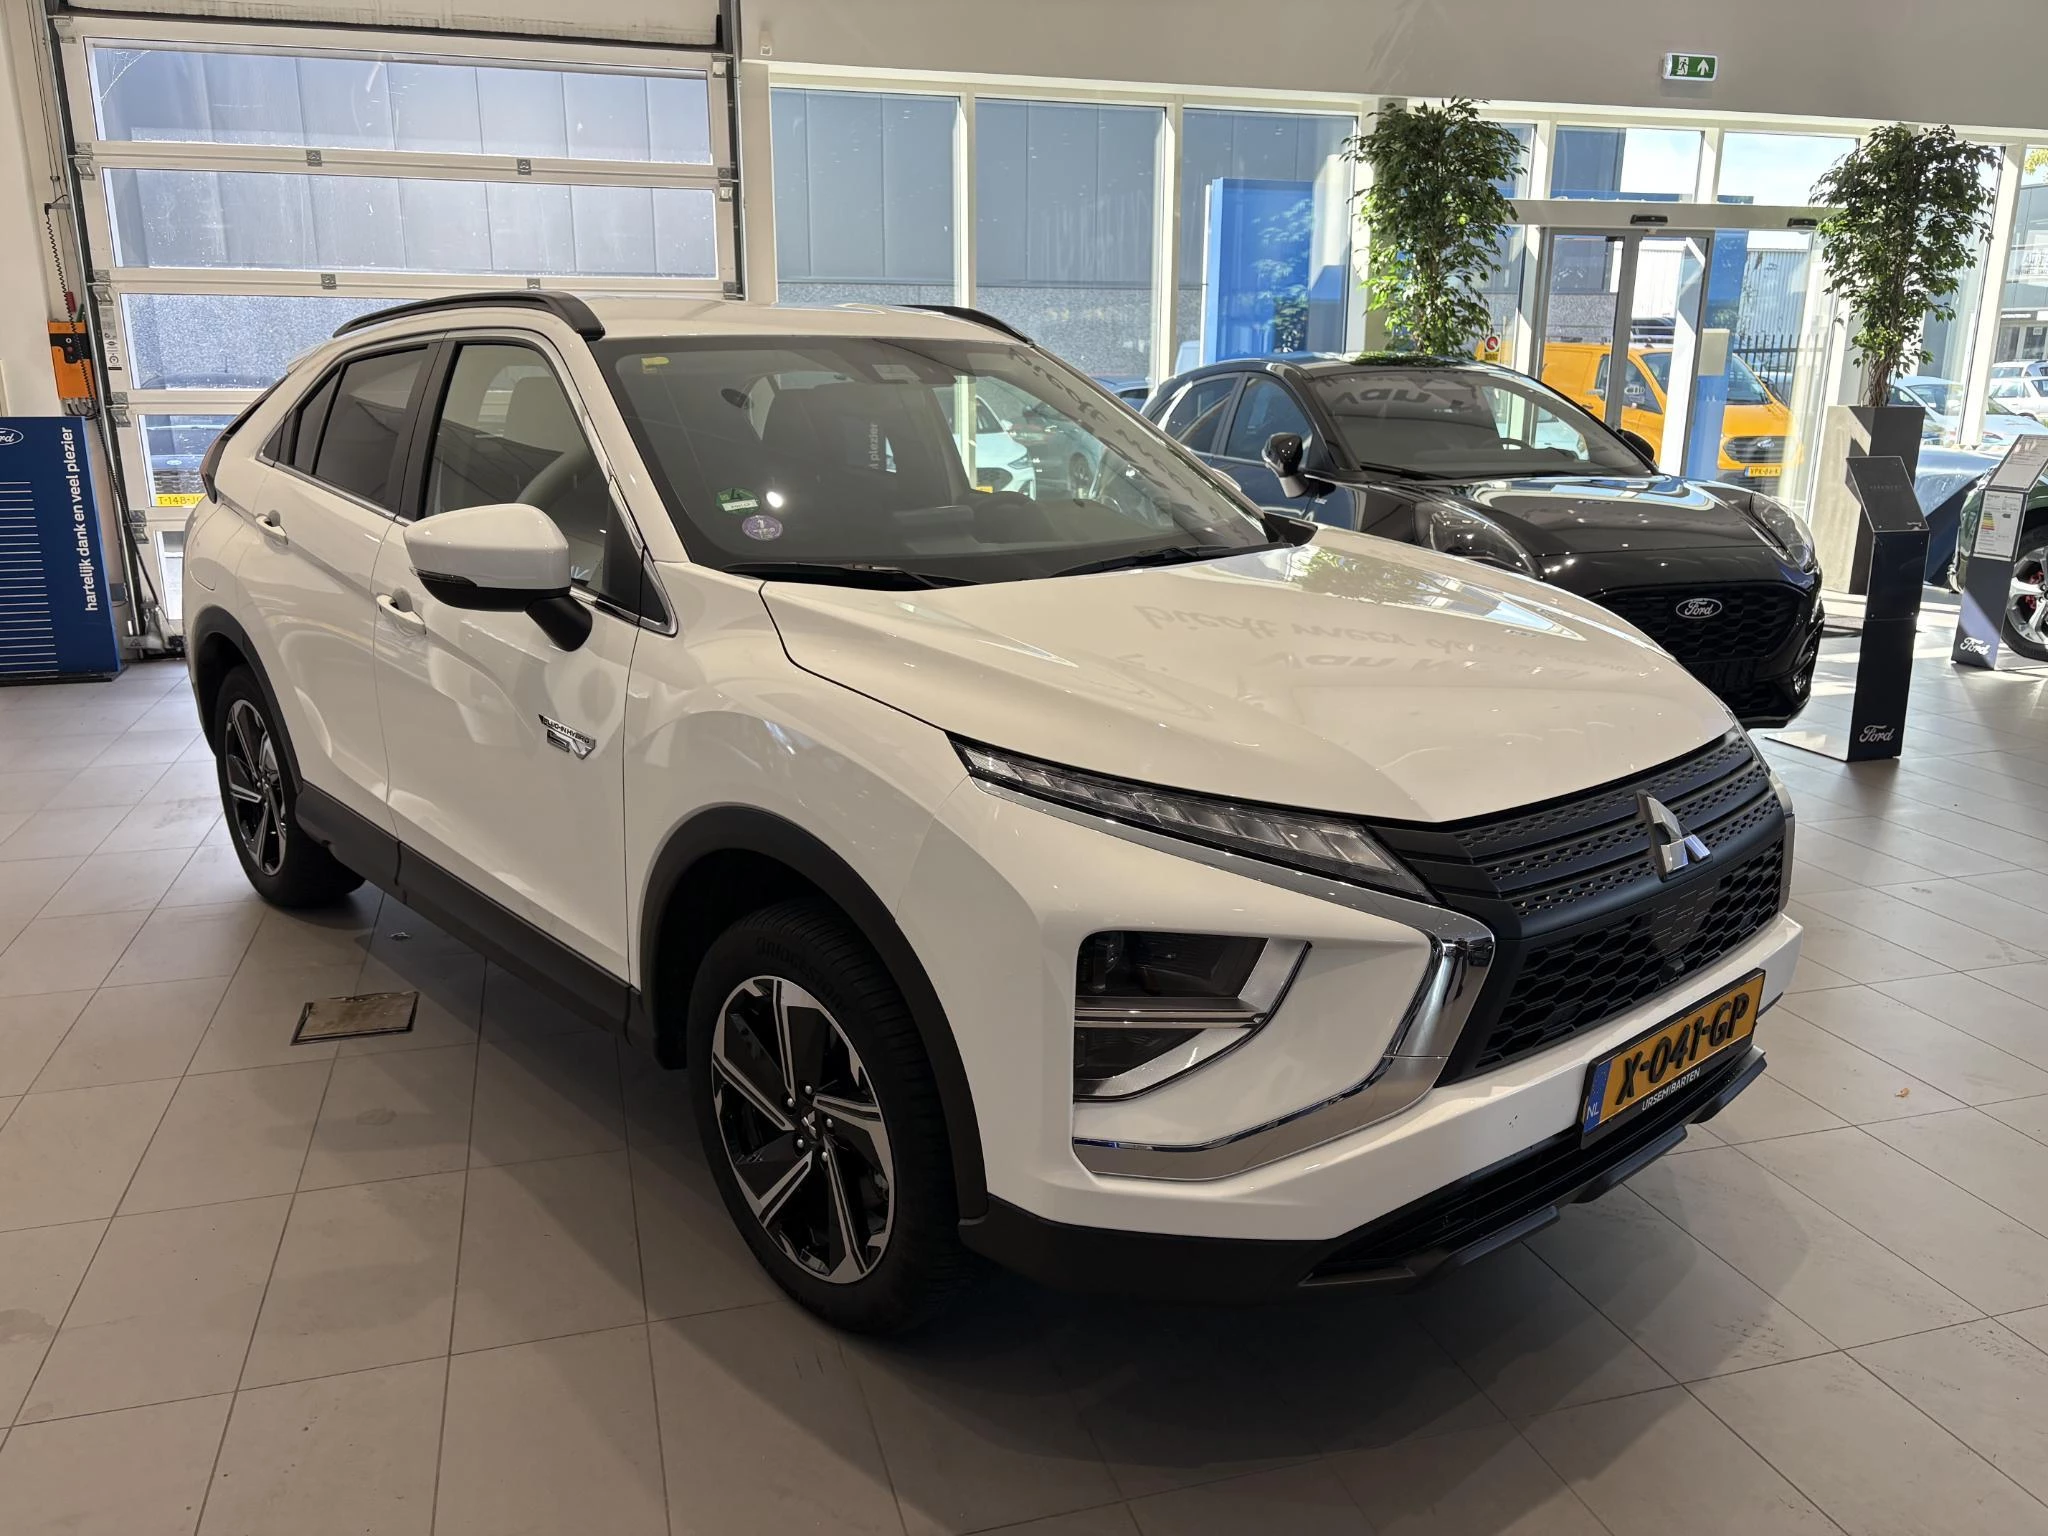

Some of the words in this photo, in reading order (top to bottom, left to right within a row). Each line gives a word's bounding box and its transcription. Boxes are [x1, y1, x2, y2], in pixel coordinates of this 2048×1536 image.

[62, 427, 80, 473] plezier
[66, 475, 81, 504] veel
[73, 505, 85, 522] en
[74, 524, 90, 557] dank
[76, 558, 98, 612] hartelijk
[1684, 600, 1714, 616] Ford
[1960, 636, 1991, 656] Ford
[1859, 724, 1896, 743] Ford
[1615, 992, 1750, 1106] X-041-GP
[1586, 1101, 1600, 1121] NL
